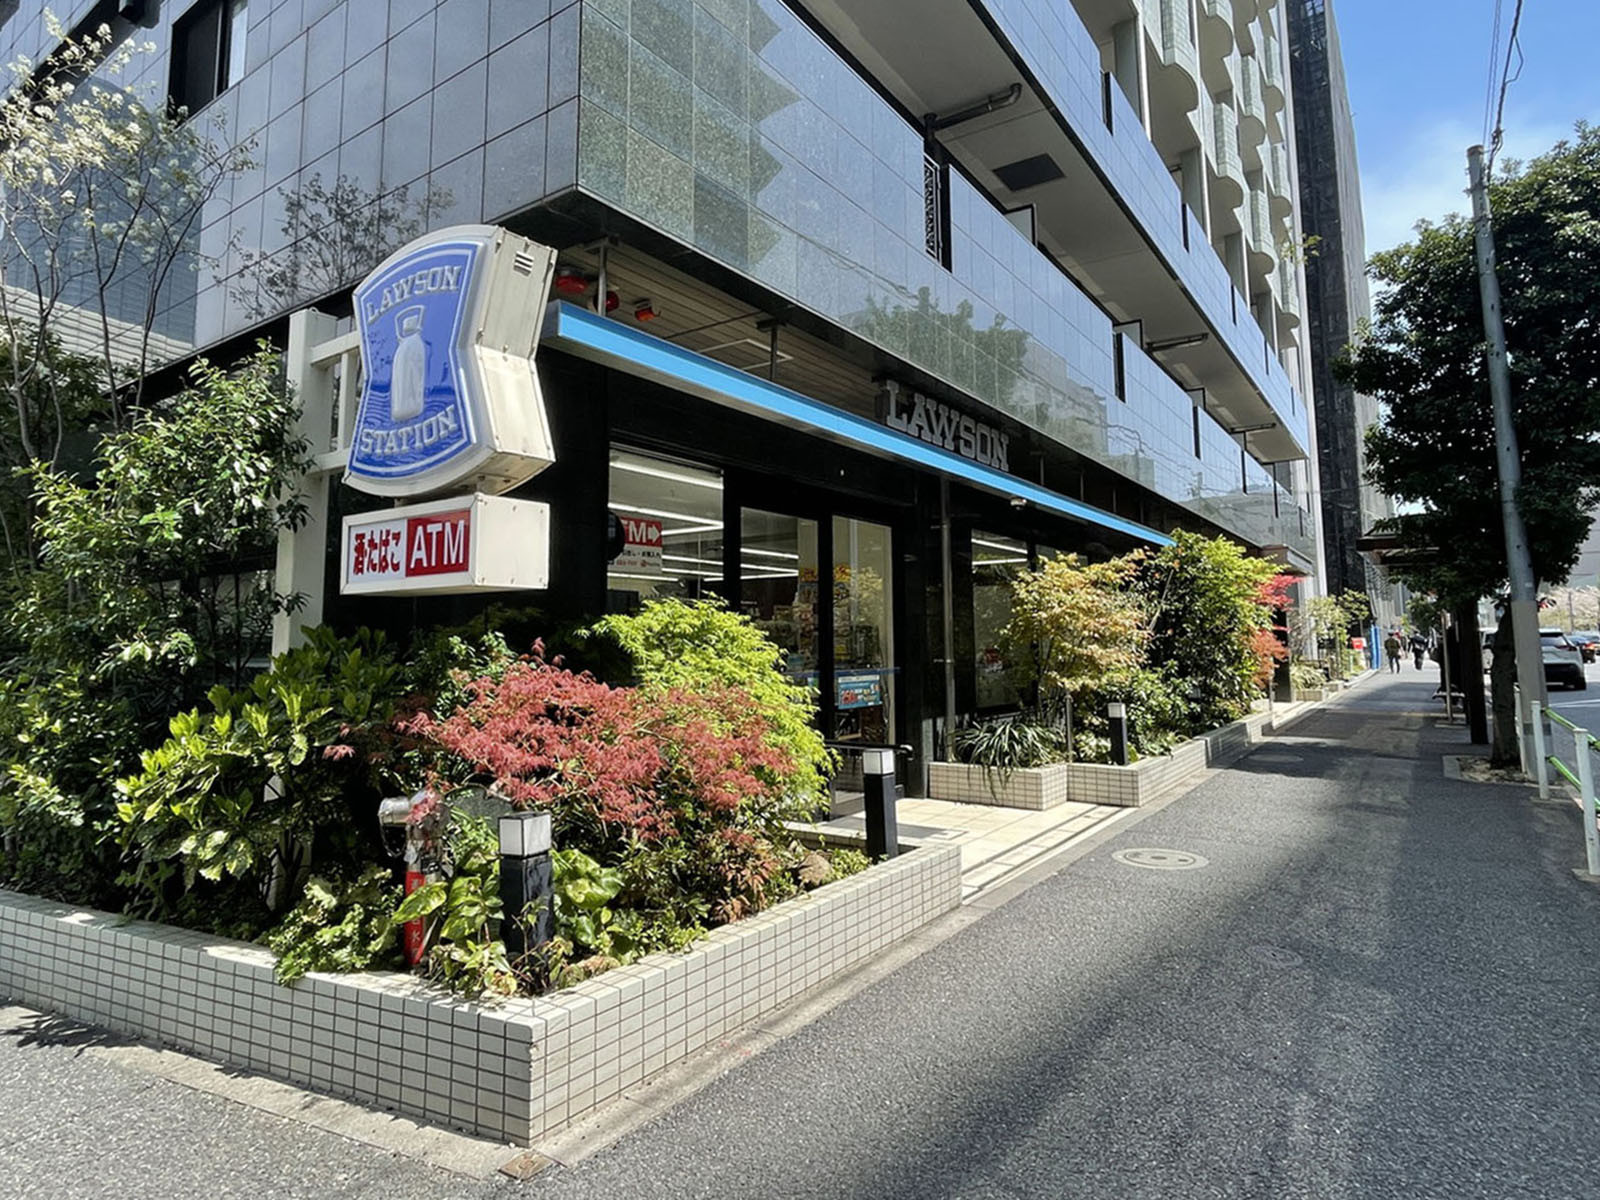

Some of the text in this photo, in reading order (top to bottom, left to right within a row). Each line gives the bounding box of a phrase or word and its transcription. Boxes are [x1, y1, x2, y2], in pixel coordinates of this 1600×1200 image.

[366, 264, 462, 324] LAWSON
[361, 404, 458, 457] STATION
[886, 379, 1010, 472] LAWSON
[410, 520, 465, 569] ATM
